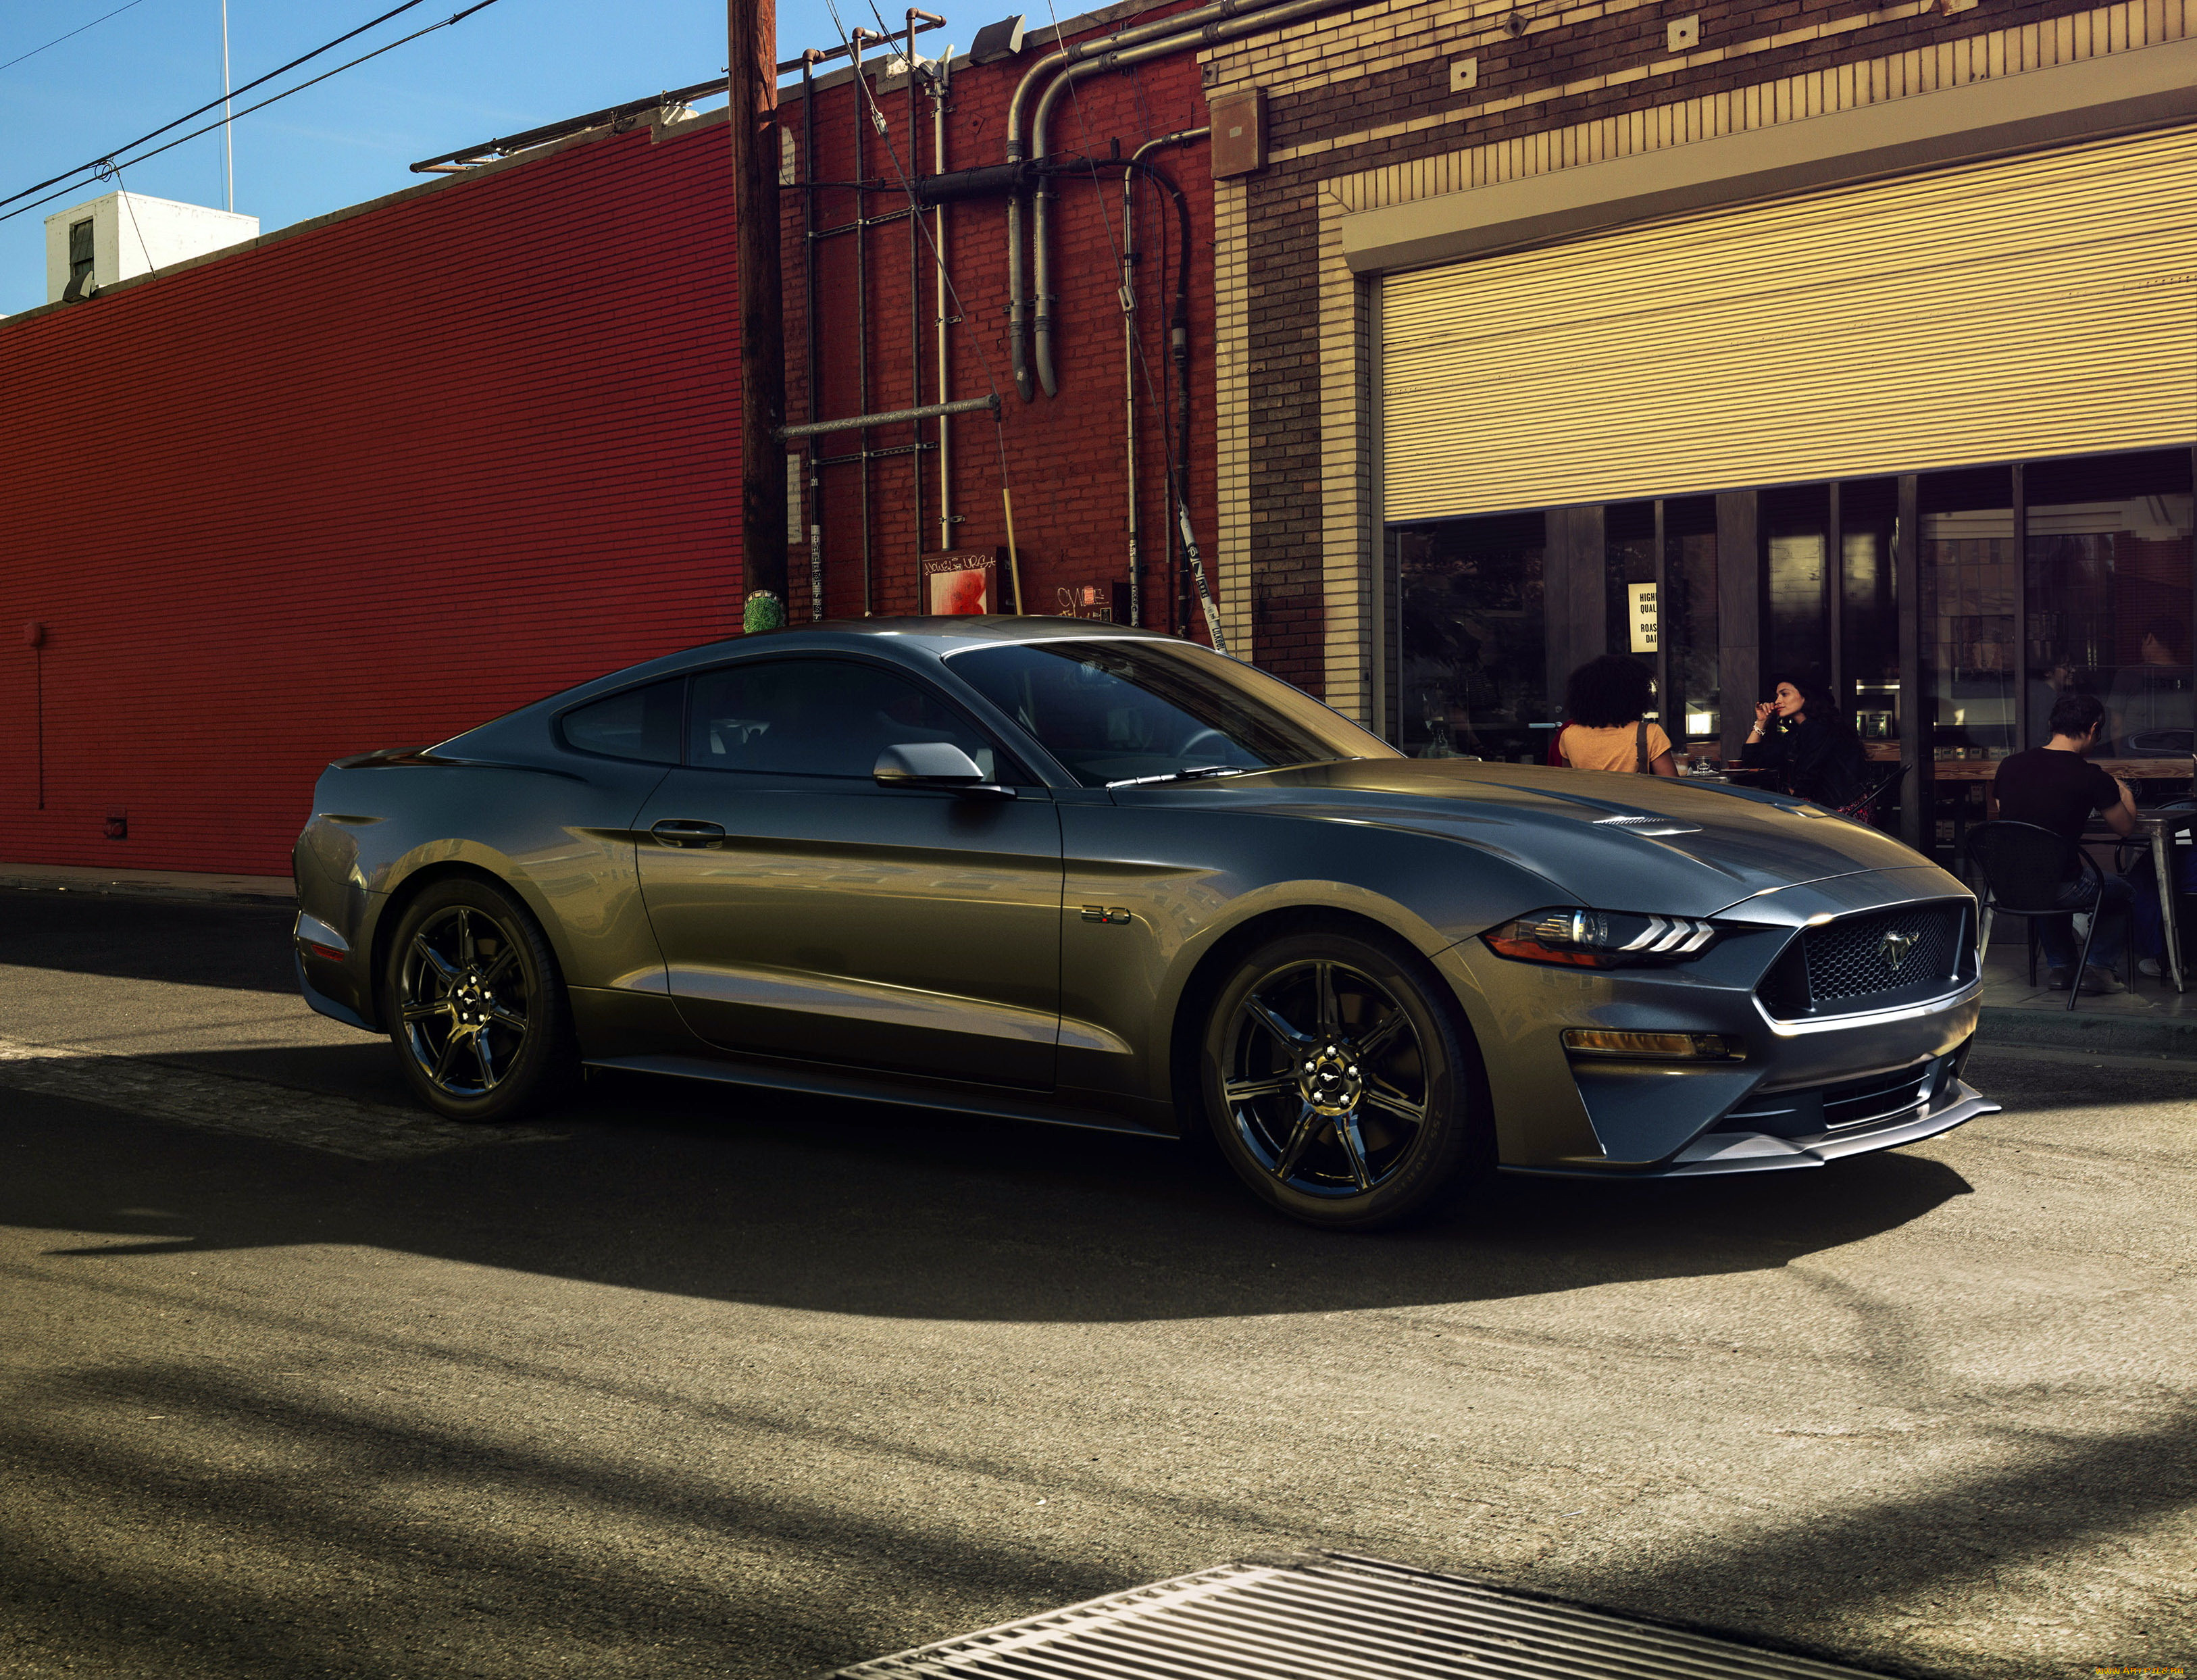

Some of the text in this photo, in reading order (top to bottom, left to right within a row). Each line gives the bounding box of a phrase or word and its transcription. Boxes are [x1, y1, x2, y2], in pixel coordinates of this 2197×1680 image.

[1640, 604, 1657, 614] QUAL
[1640, 623, 1657, 632] ROAS
[1646, 634, 1657, 643] DAI
[1081, 905, 1131, 925] 5.0
